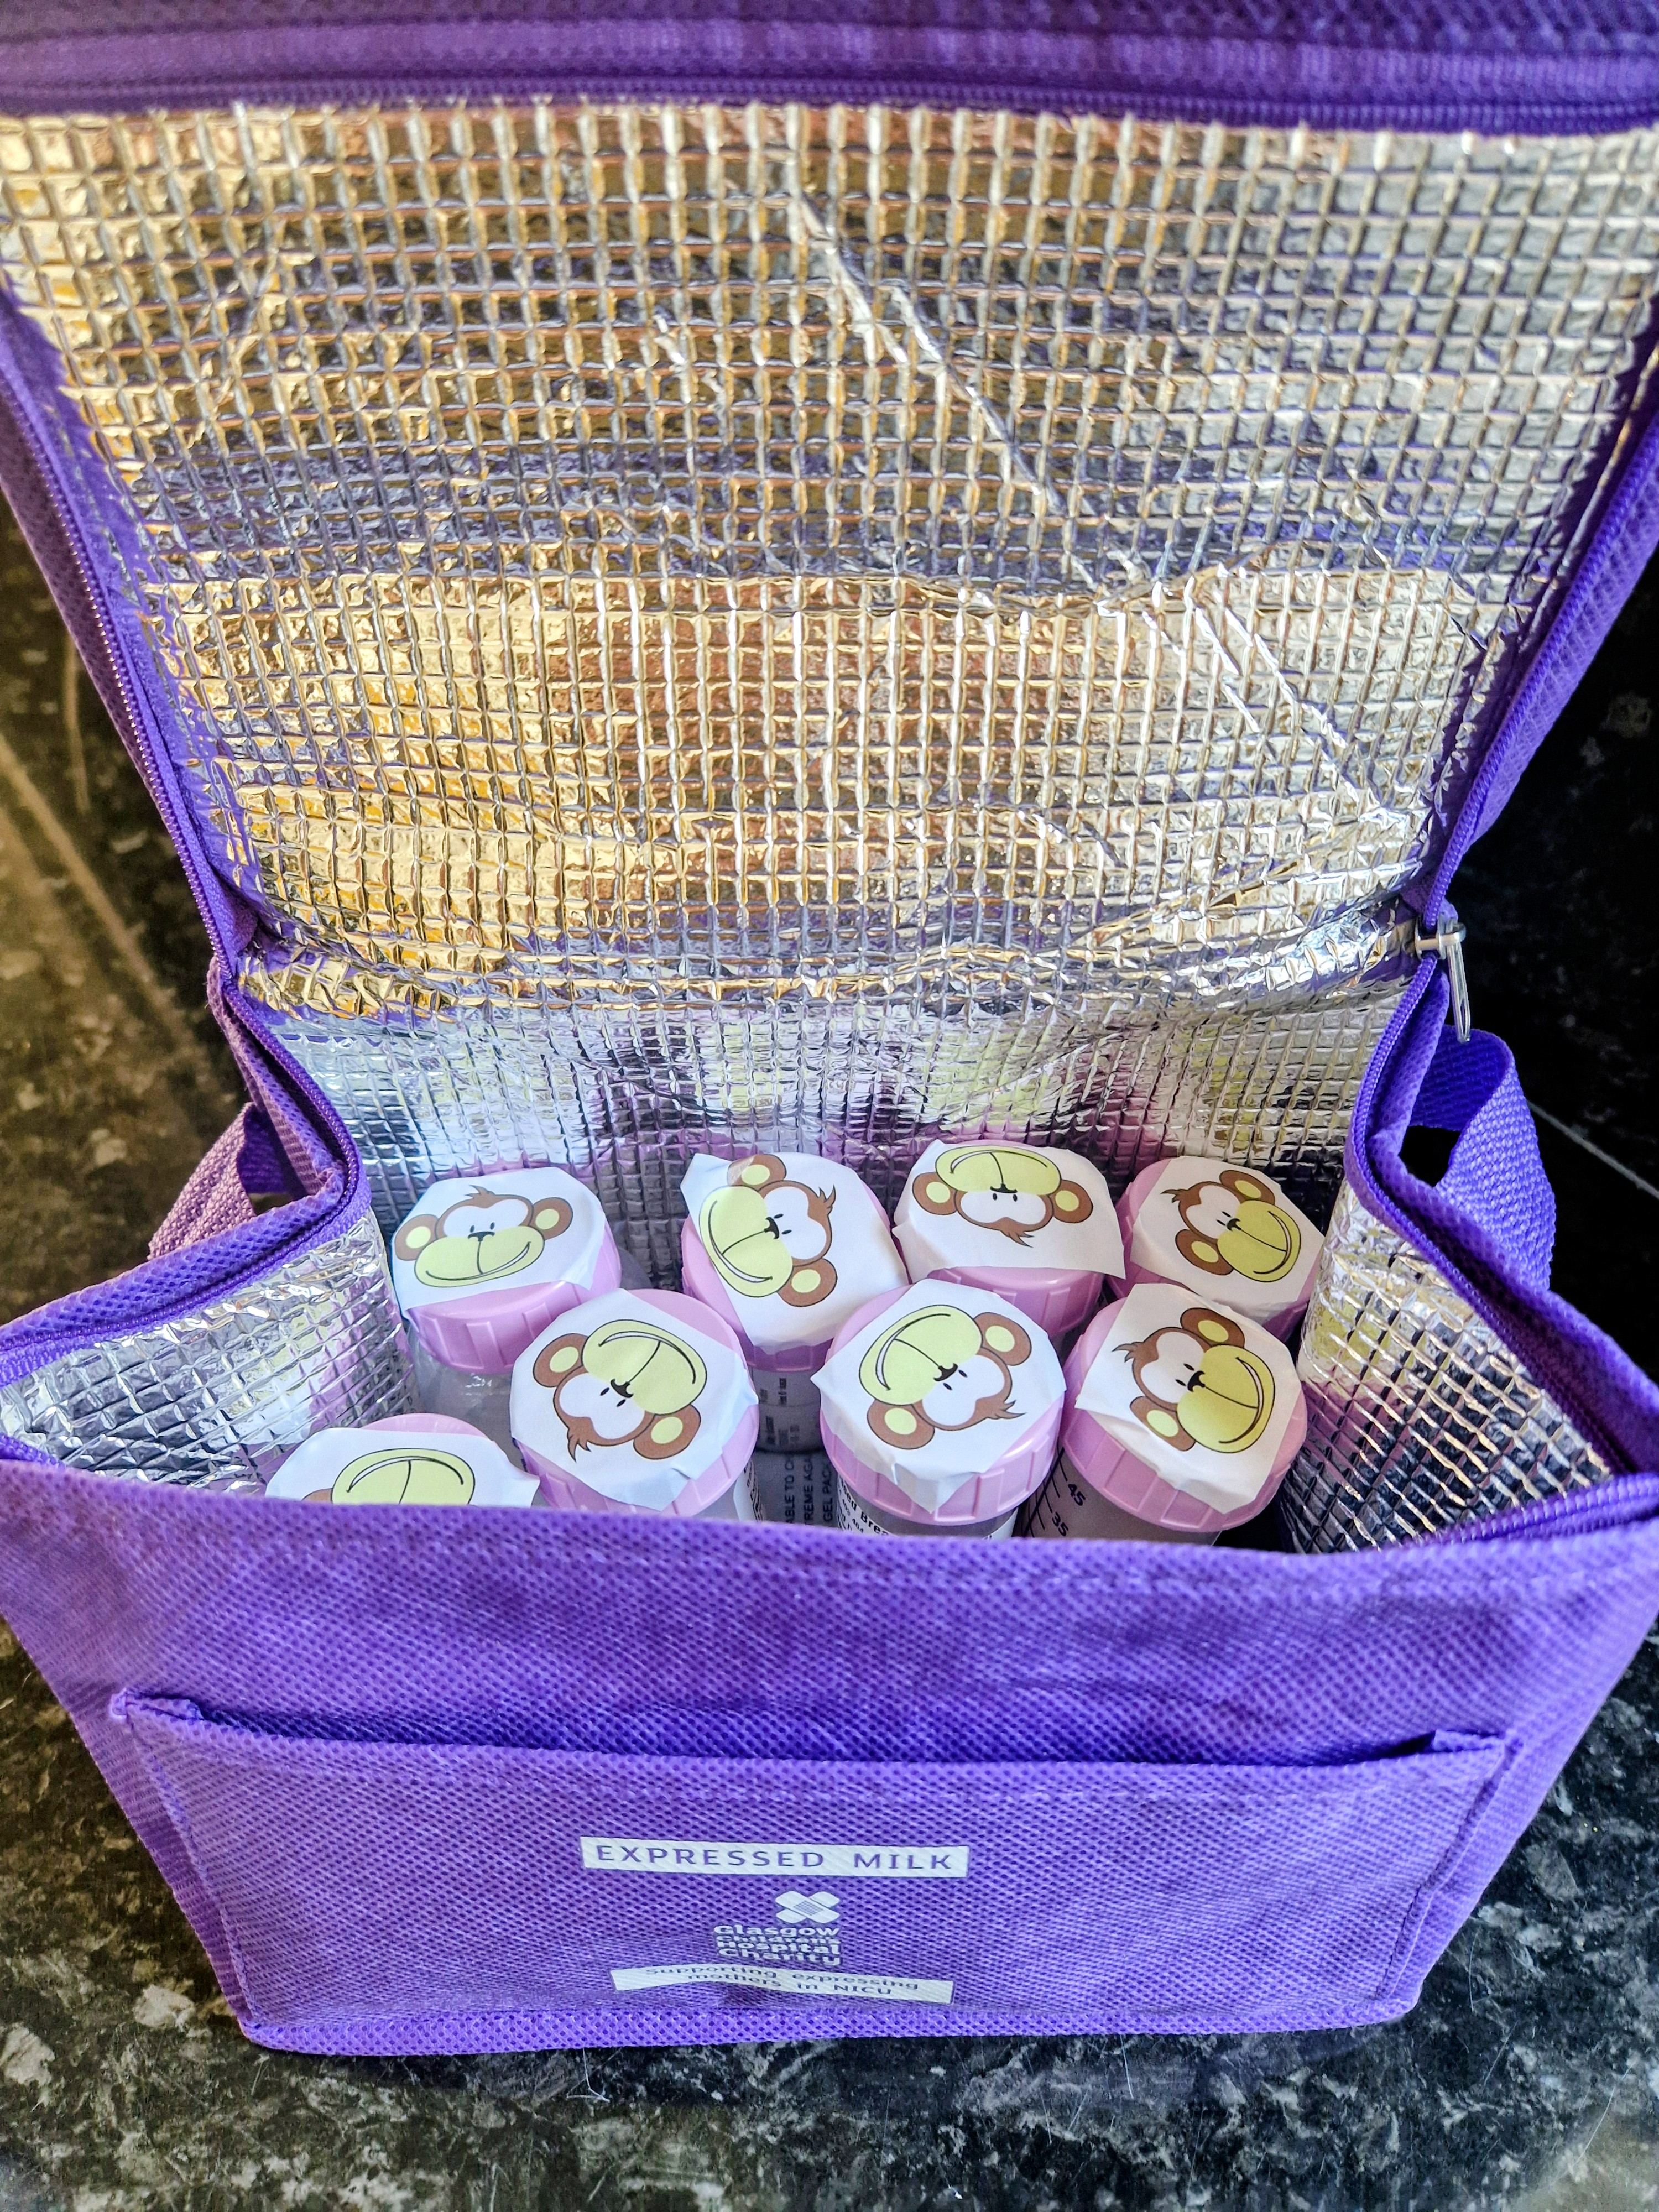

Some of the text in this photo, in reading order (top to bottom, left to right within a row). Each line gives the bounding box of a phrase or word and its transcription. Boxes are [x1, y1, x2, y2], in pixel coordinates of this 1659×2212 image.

[804, 1484, 814, 1525] REME
[1068, 1484, 1086, 1506] 45
[822, 1498, 833, 1522] GEL
[1052, 1512, 1068, 1536] 35
[596, 1845, 951, 1869] EXPRESSED MILK
[714, 1924, 840, 1937] Glasgow
[717, 1942, 841, 1954] Hospital
[719, 1948, 841, 1965] Charity
[688, 1974, 781, 1987] mothers
[833, 1984, 891, 1994] NICU
[792, 1973, 918, 1990] expressing
